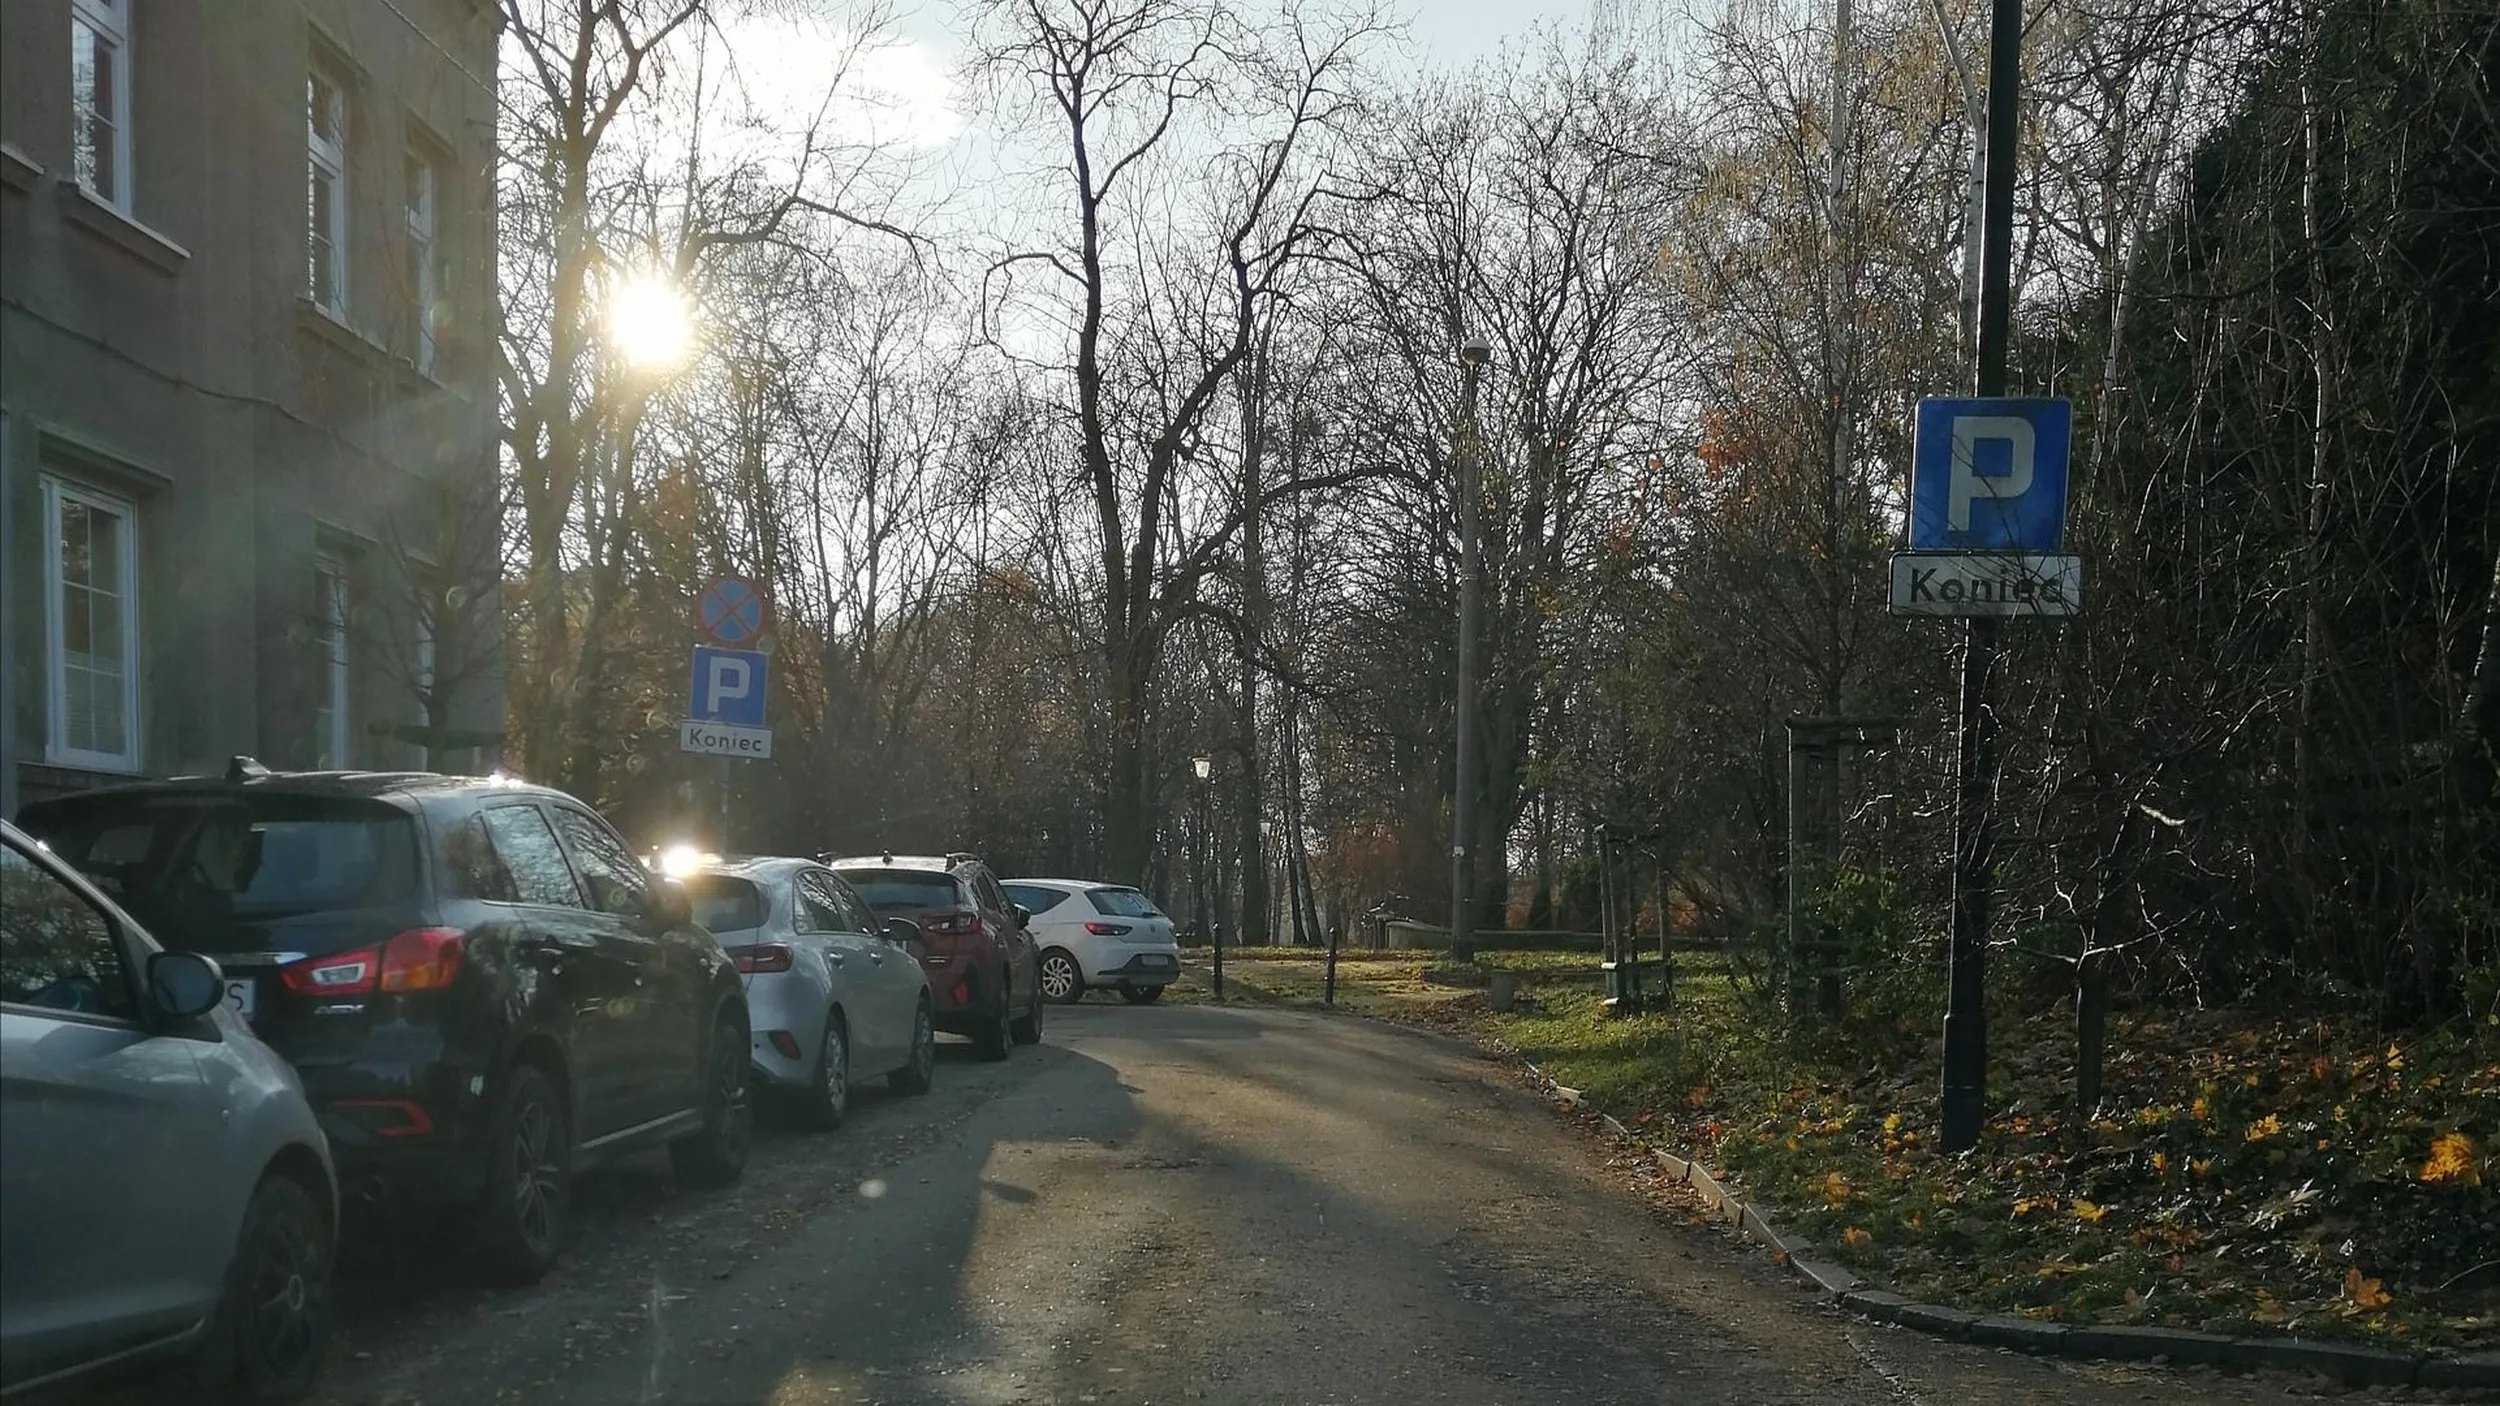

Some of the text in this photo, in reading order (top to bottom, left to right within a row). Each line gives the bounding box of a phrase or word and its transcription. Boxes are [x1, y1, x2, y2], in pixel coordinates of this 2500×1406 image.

[1947, 416, 2036, 532] P
[1910, 567, 2061, 604] Koniec
[707, 656, 751, 713] P
[689, 728, 762, 752] Koniec
